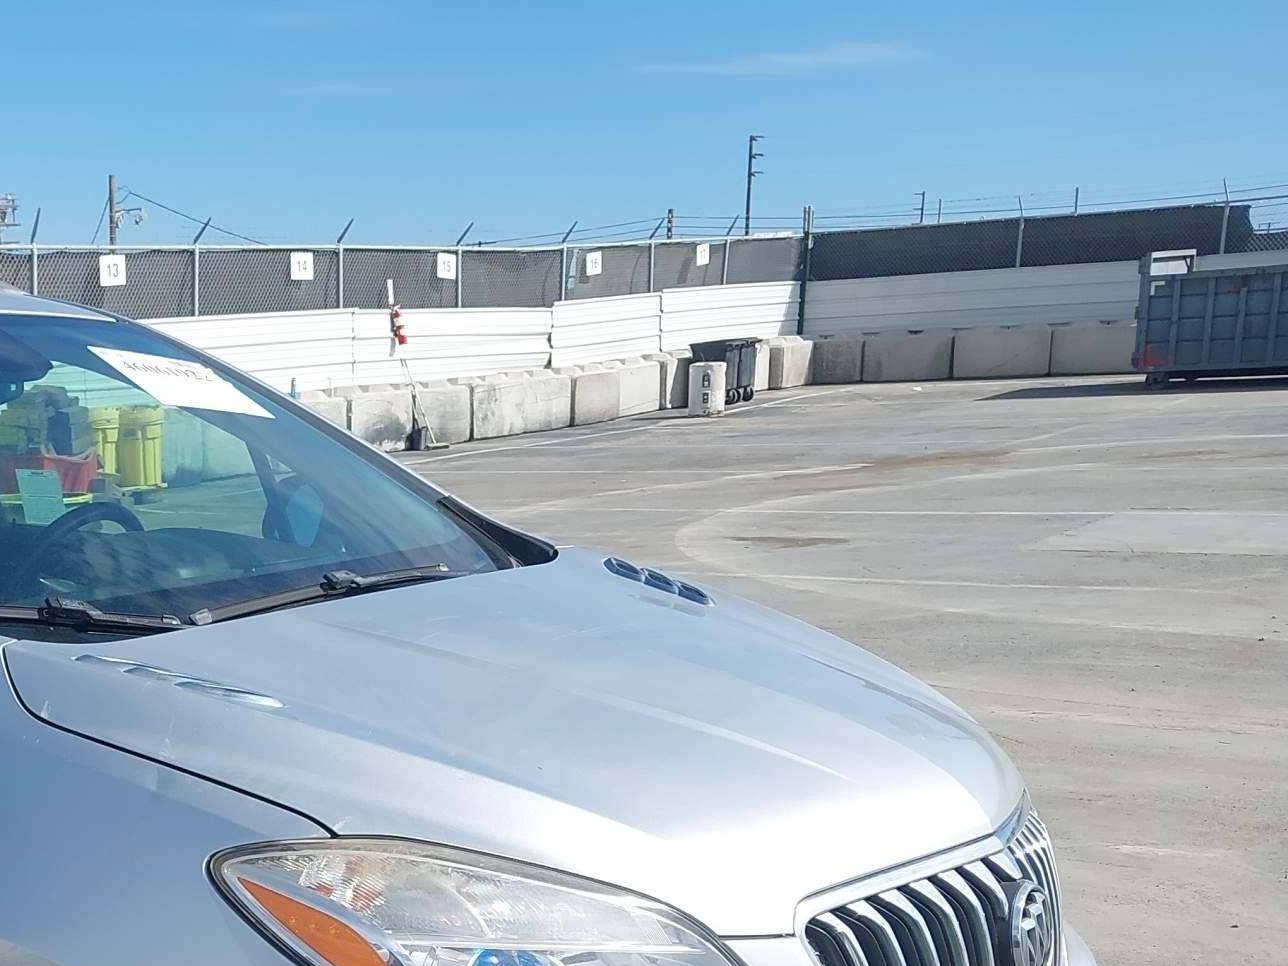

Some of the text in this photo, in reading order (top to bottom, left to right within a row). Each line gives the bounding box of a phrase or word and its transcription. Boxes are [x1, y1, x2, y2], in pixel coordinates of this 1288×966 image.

[106, 263, 119, 278] 13
[297, 260, 308, 272] 14
[442, 260, 452, 273] 15
